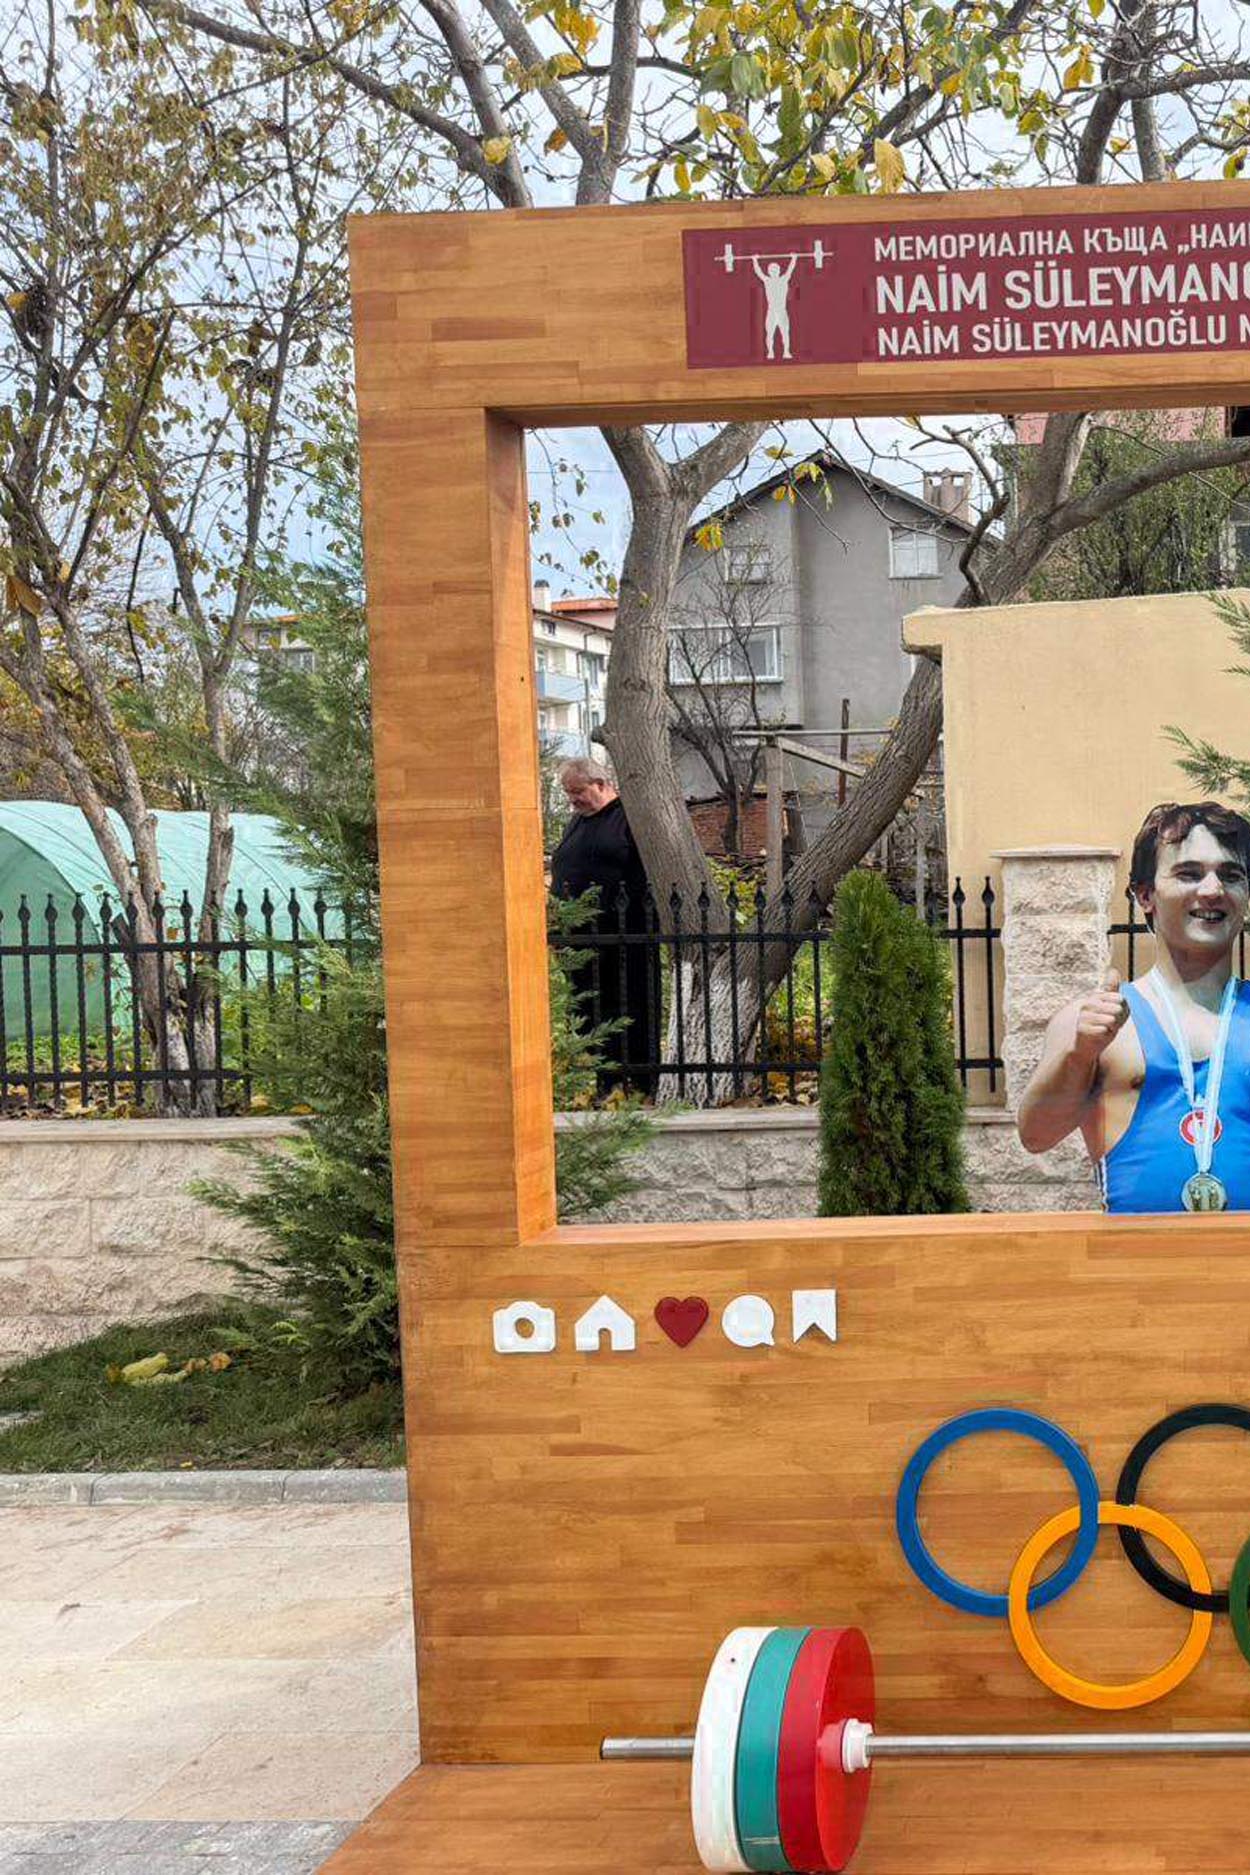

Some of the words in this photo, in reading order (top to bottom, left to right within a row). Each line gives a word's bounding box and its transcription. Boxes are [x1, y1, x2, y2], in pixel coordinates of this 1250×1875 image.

[874, 229, 1074, 262] МЕМОРИАЛНА
[1083, 225, 1168, 256] КЪЩА
[876, 264, 988, 314] NAİM
[878, 319, 960, 356] NAİM
[972, 308, 1227, 353] SÜLEYMANOĞLU
